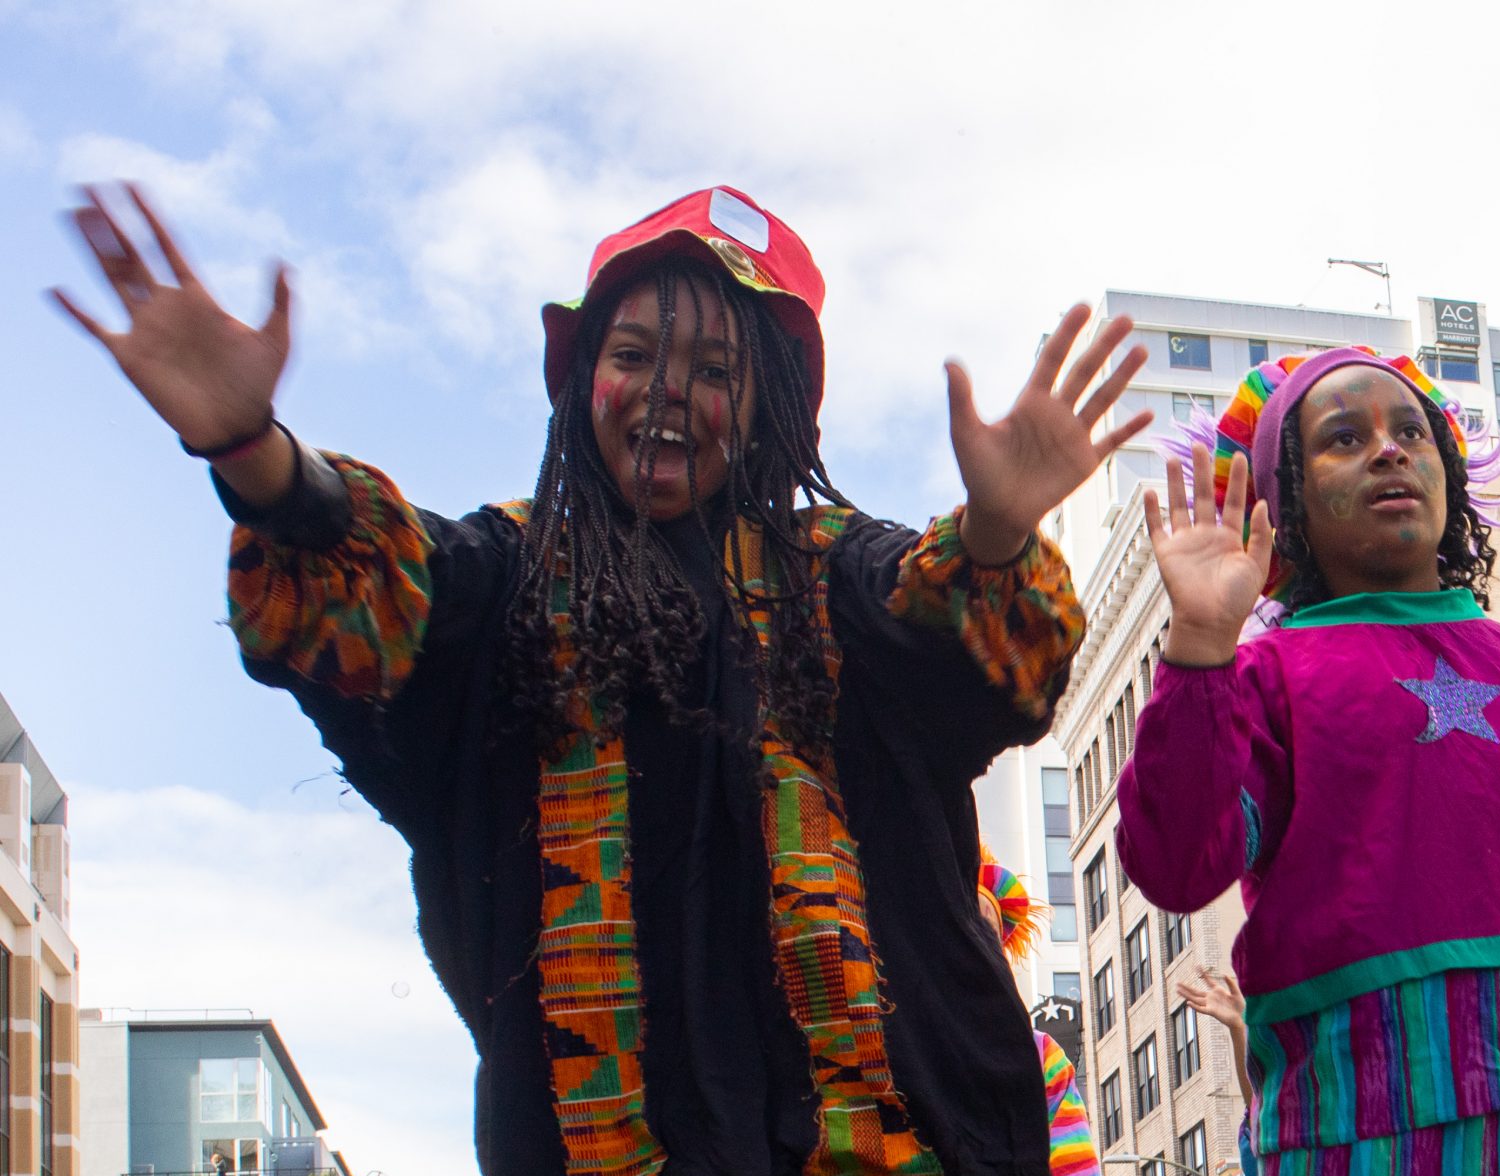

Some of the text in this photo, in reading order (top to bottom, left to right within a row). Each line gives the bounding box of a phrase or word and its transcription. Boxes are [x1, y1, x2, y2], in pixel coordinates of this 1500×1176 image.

[1440, 304, 1474, 322] AC
[1440, 321, 1475, 330] HOTELS
[1442, 334, 1475, 343] MARRIOTT
